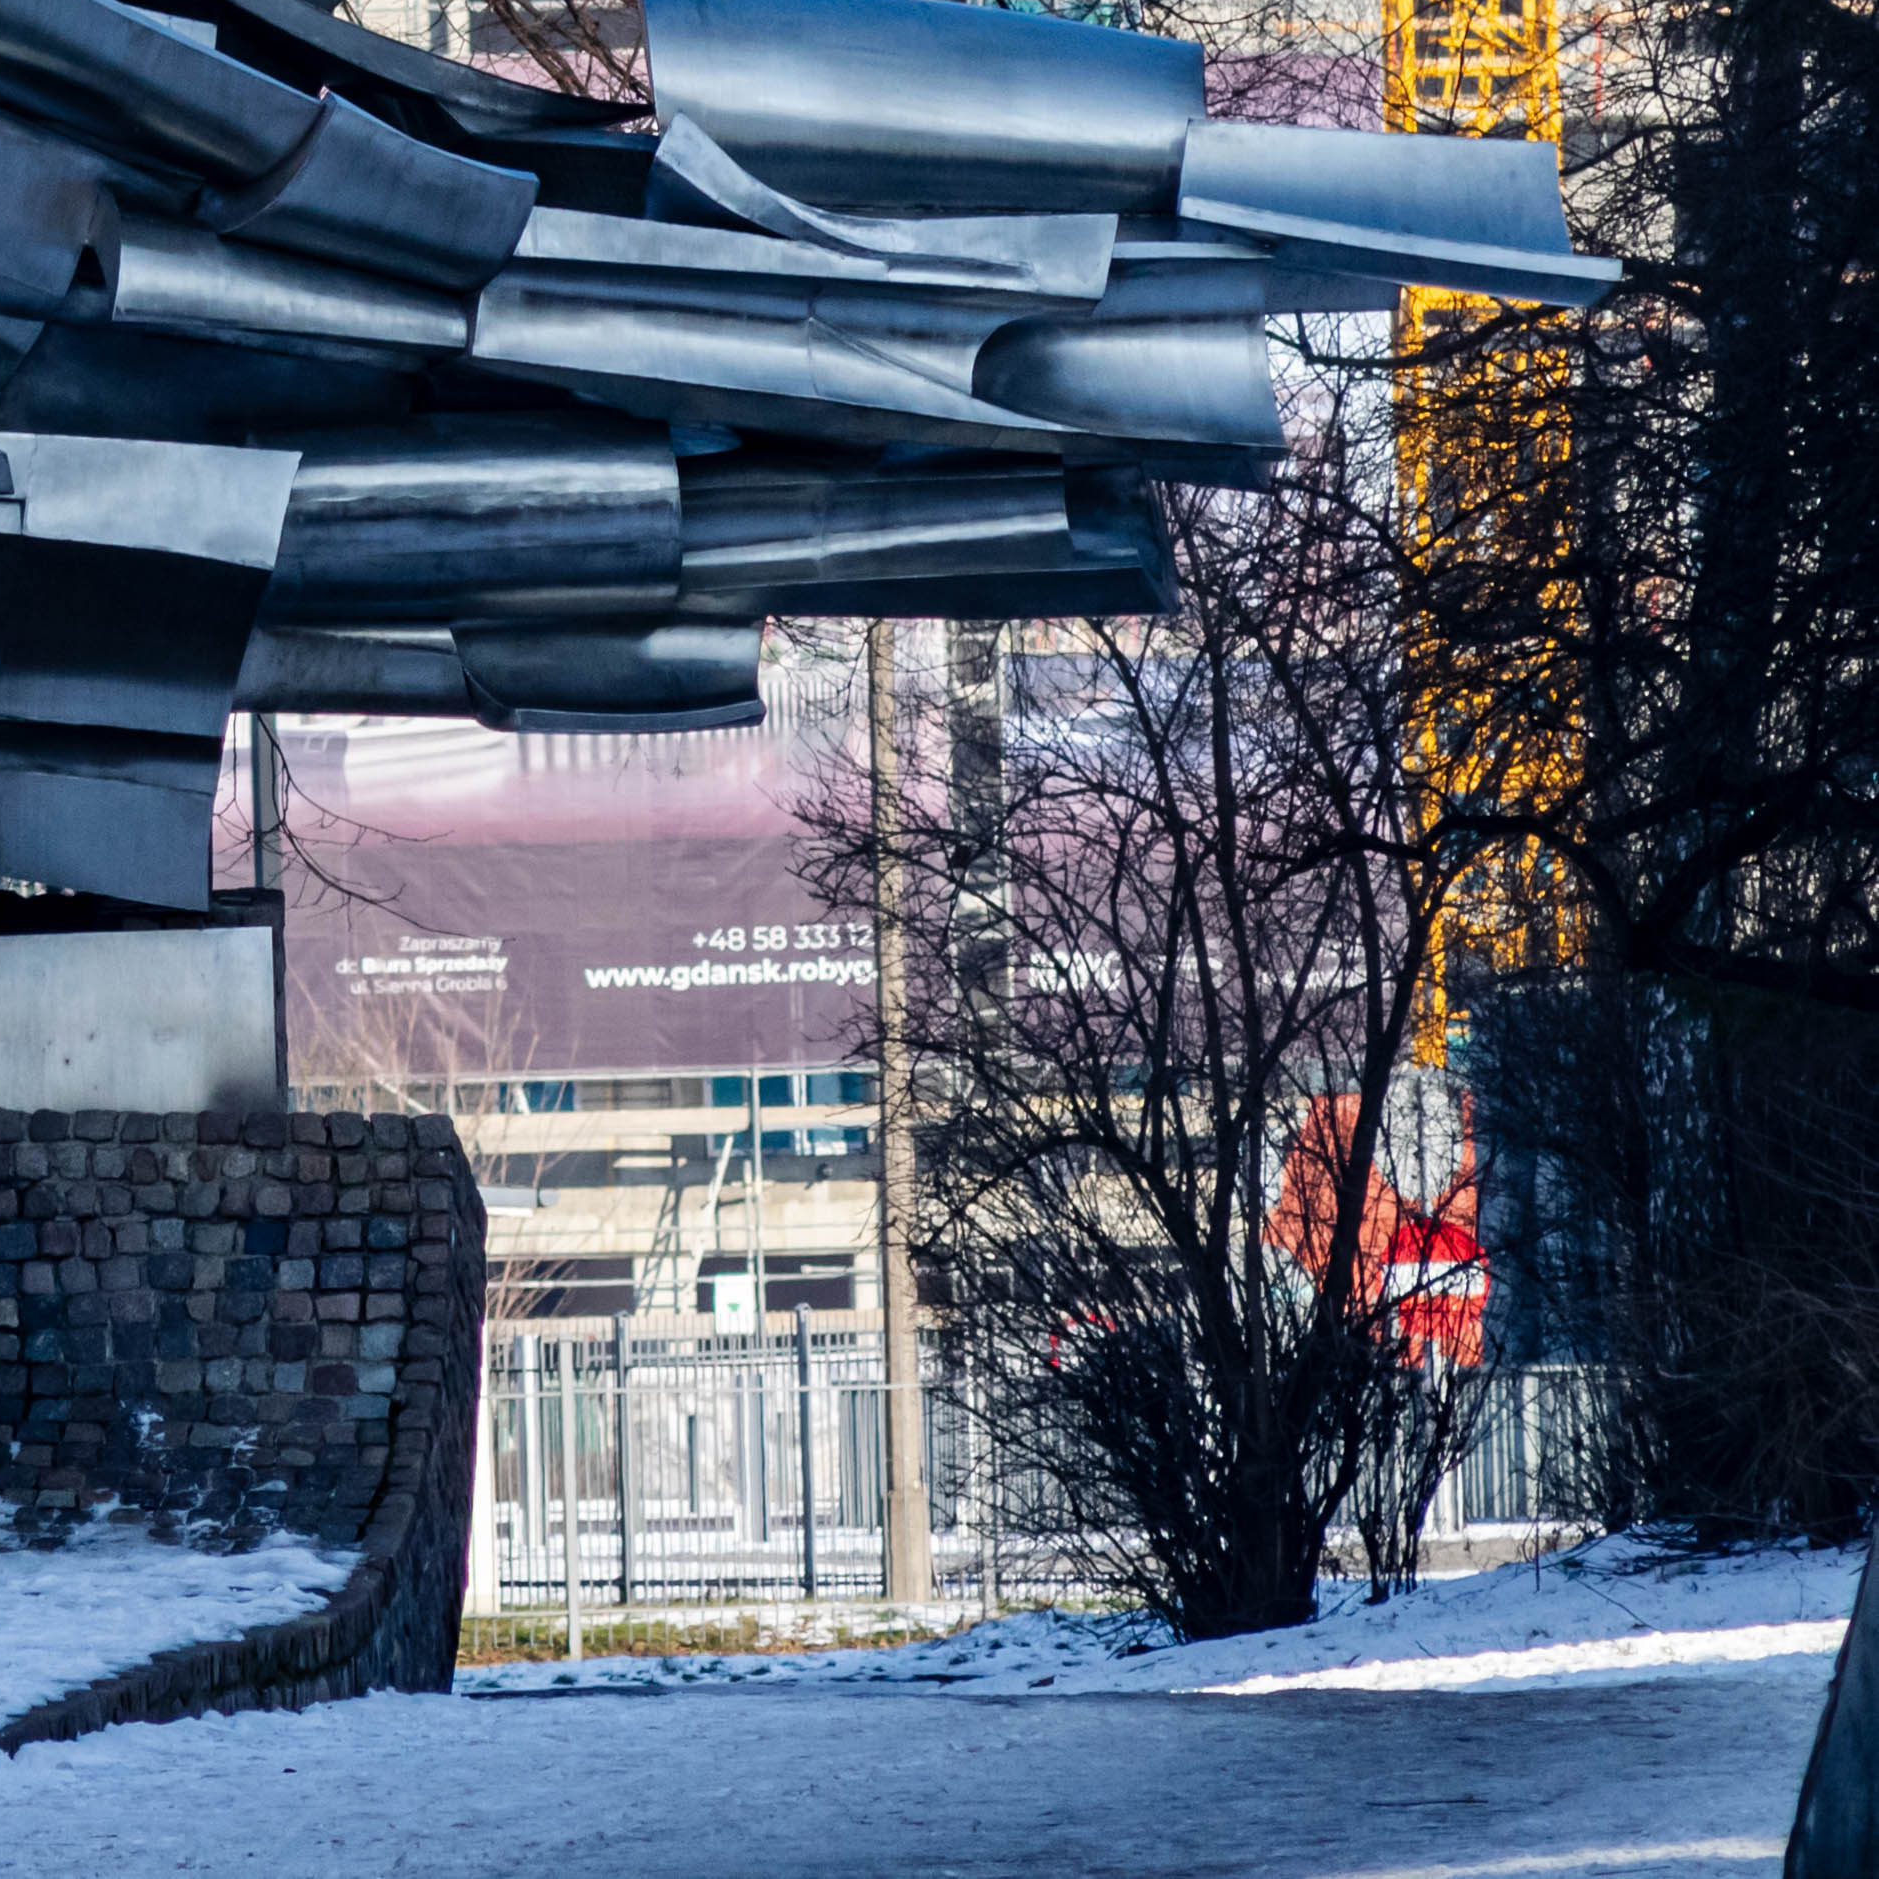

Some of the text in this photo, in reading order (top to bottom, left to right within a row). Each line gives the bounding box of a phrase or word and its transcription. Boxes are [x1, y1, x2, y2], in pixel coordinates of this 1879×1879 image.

[692, 925, 746, 951] +48
[752, 925, 787, 951] 58
[793, 924, 841, 950] 333
